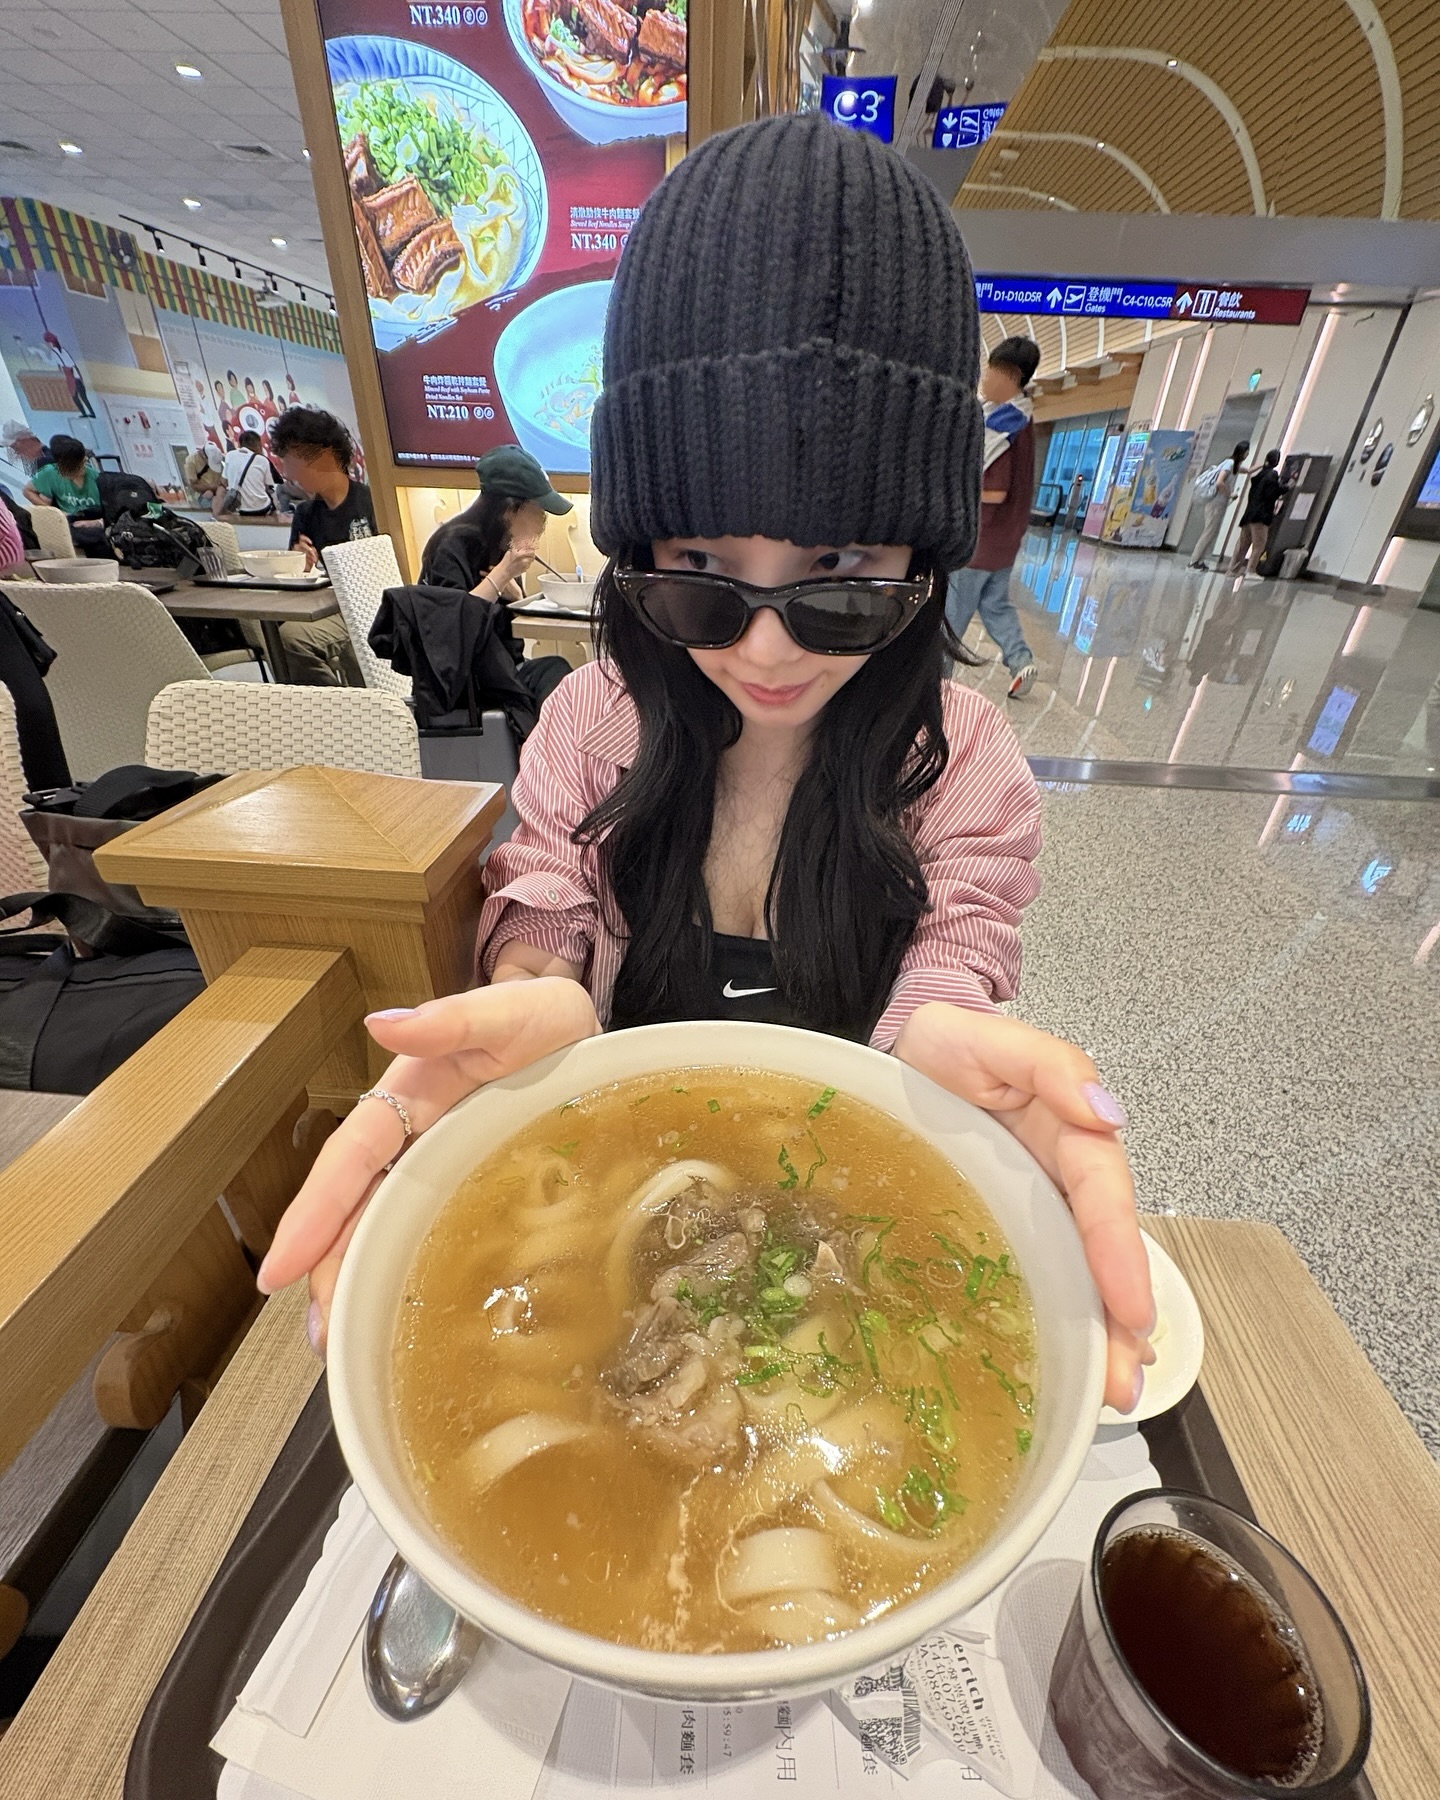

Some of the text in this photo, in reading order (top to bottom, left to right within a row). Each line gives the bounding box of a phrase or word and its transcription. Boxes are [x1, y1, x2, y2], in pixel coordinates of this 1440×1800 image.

[409, 5, 460, 25] NT.340
[833, 90, 879, 122] C3
[571, 233, 617, 249] NT.340
[993, 290, 1043, 304] D1-D10,D5R
[1087, 286, 1173, 308] 登機門 C4-C10,C5R
[1218, 291, 1243, 308] 餐飲
[1085, 302, 1106, 313] Gates
[1213, 307, 1256, 320] Restaurants
[427, 404, 469, 419] NT.210
